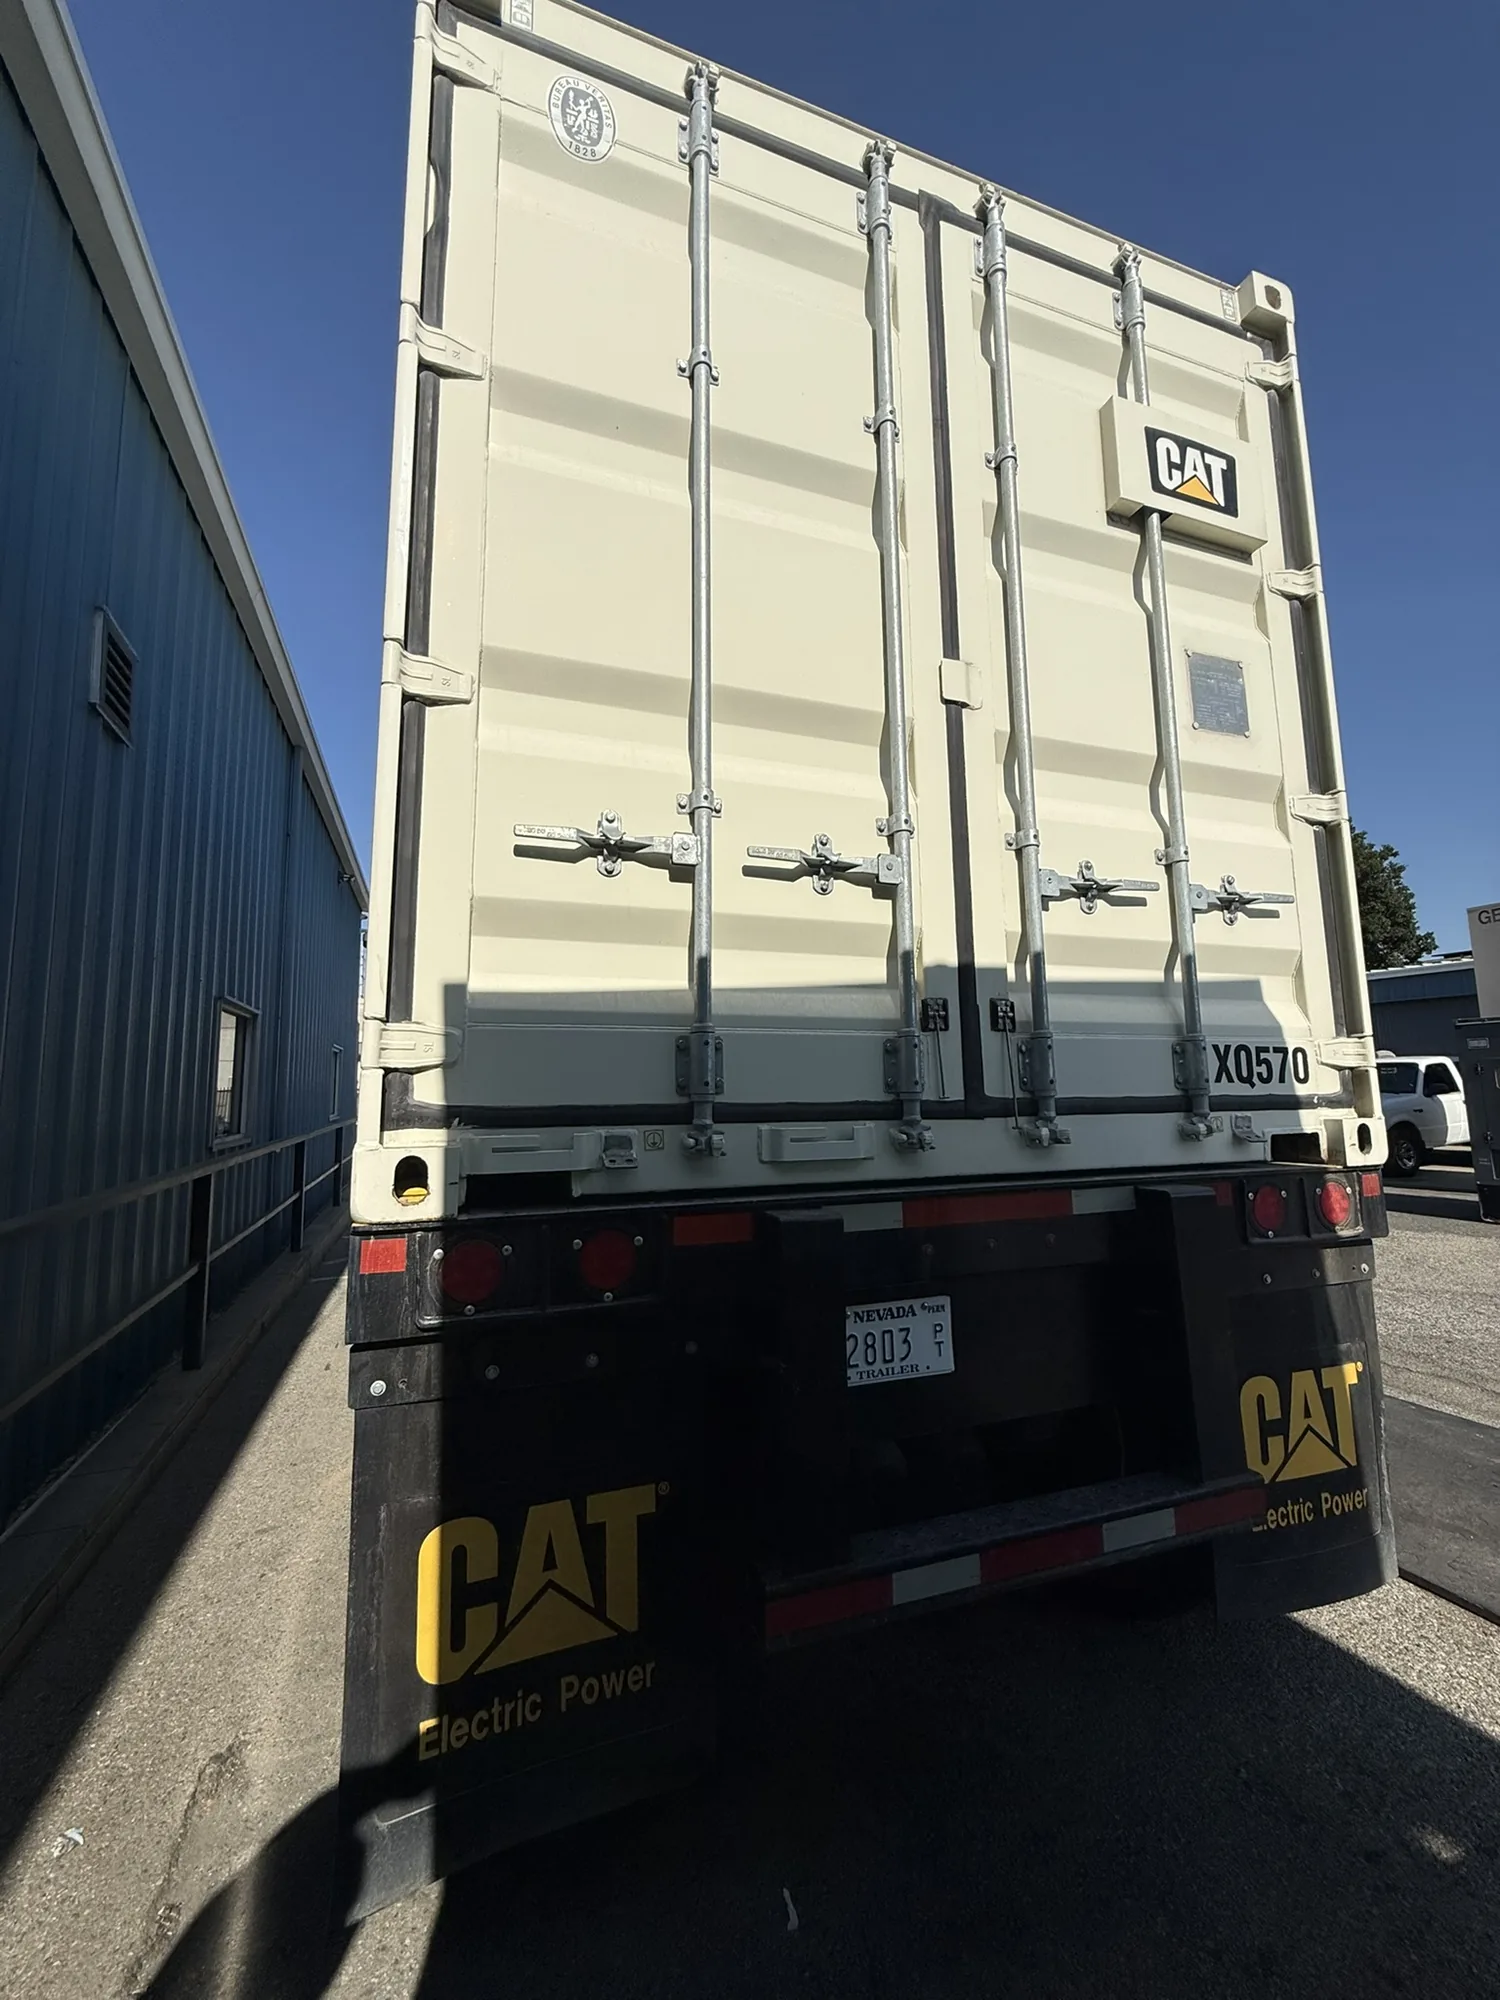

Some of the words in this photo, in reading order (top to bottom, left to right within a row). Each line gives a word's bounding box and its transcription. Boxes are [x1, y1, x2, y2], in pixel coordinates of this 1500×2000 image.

[552, 79, 580, 109] BUREAU
[584, 83, 613, 129] VERITAS
[568, 140, 597, 158] 1828
[1155, 436, 1227, 507] CAT
[1211, 1044, 1310, 1089] XQ570
[853, 1304, 918, 1324] NEVADA
[847, 1326, 912, 1369] 2803
[856, 1363, 920, 1380] TRAILER
[1321, 1487, 1368, 1519] Power
[418, 1688, 542, 1761] Electric
[560, 1661, 656, 1712] Power
